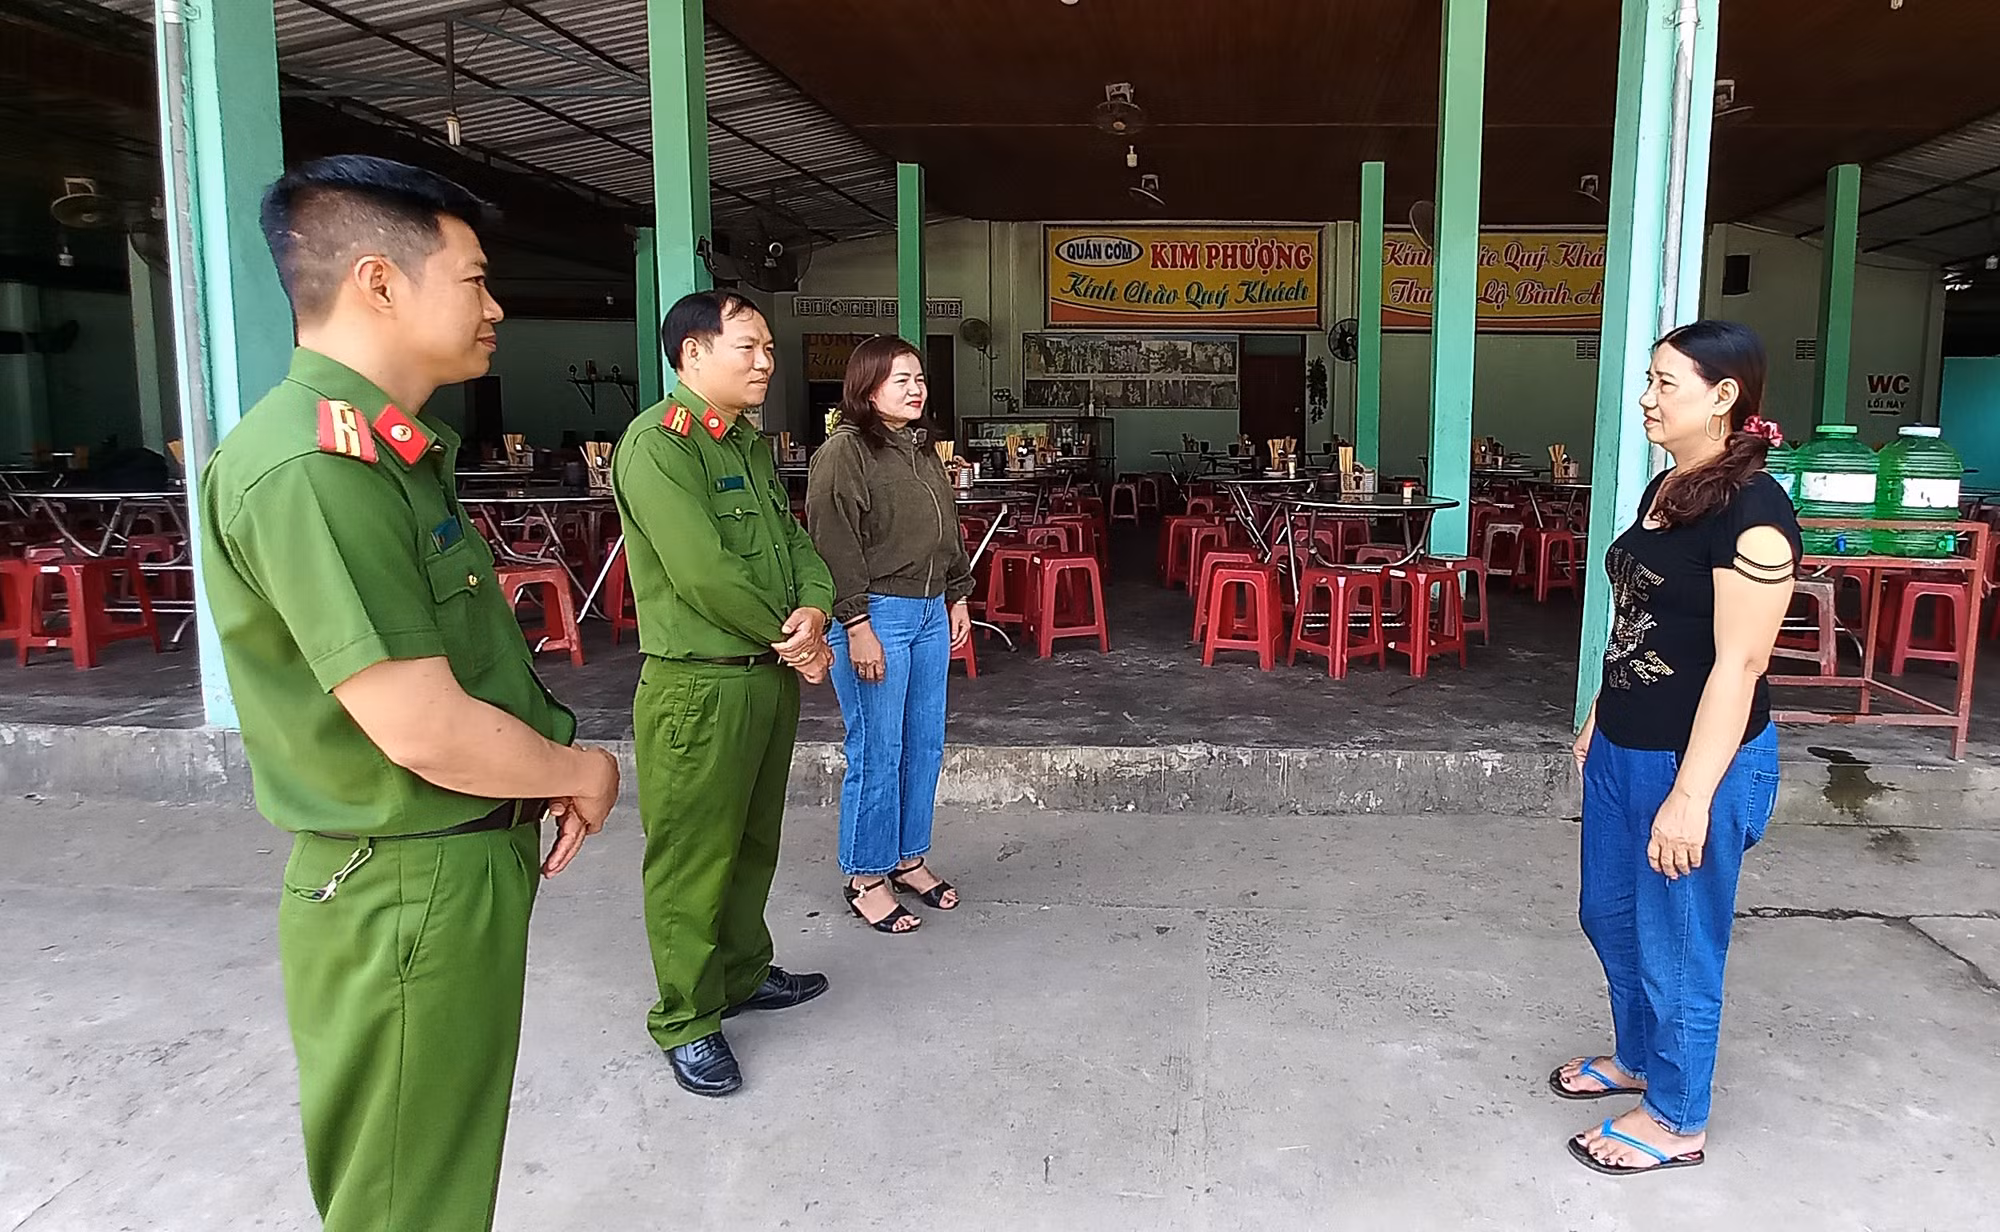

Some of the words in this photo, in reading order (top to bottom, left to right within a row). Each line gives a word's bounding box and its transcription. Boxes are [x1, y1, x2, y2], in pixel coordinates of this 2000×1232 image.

[1067, 239, 1102, 260] QUÁN
[1105, 241, 1132, 259] CƠM
[1151, 242, 1199, 269] KIM
[1206, 237, 1313, 275] PHƯỢNG
[1504, 241, 1548, 272] Quý
[1552, 242, 1604, 268] Khá
[1060, 272, 1117, 301] Kính
[1124, 280, 1178, 304] Chào
[1185, 281, 1229, 309] Quý
[1235, 277, 1309, 304] Khách
[1478, 279, 1508, 311] Lộ
[1515, 279, 1571, 305] Bình
[1573, 281, 1602, 305] A
[1866, 375, 1910, 394] WC
